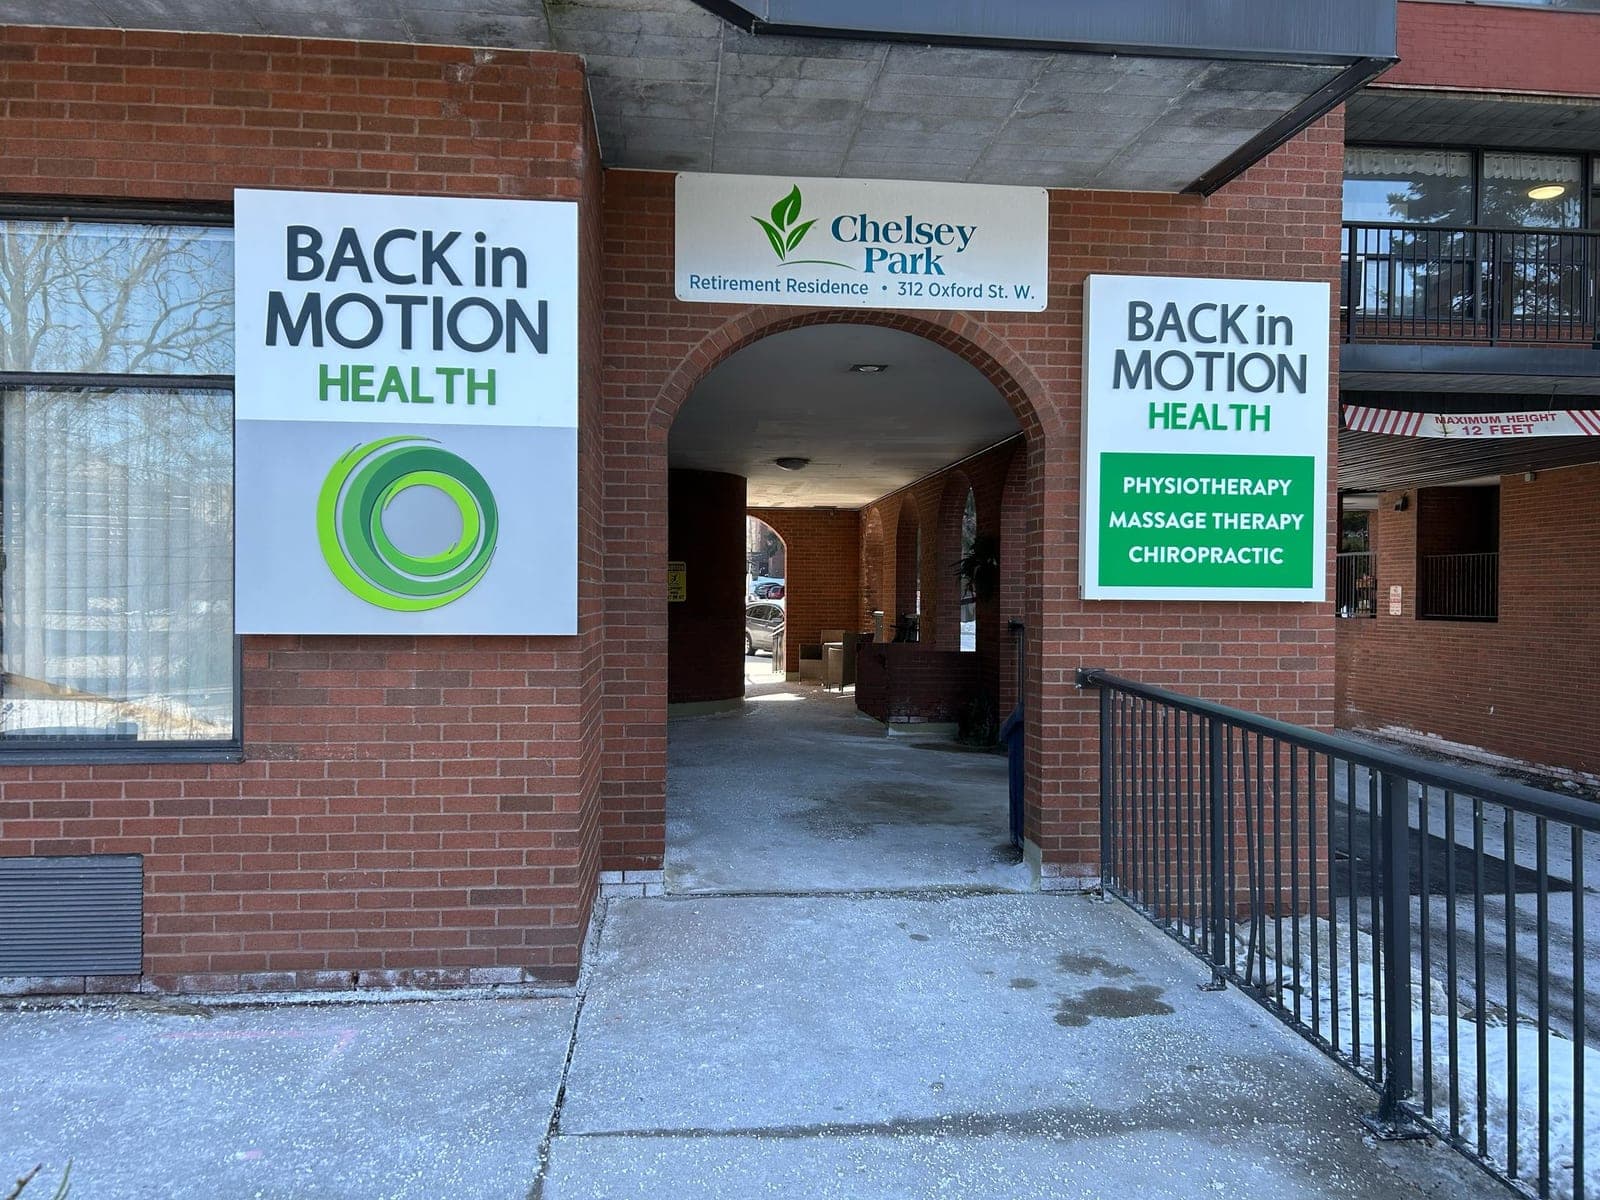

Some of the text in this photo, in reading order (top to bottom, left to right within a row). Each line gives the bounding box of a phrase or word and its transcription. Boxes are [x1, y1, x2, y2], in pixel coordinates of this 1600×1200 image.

[831, 213, 977, 253] Chelsey
[286, 225, 528, 289] BACK in
[864, 247, 946, 276] Park
[689, 274, 1035, 300] Retirement Residence 312 Oxford St. W.
[265, 290, 549, 355] MOTION
[1127, 300, 1294, 346] BACK in
[319, 363, 497, 406] HEALTH
[1112, 348, 1307, 394] MOTION
[1148, 401, 1271, 432] HEALTH
[1434, 413, 1557, 425] MAXIMUM HEIGHT
[1462, 423, 1535, 435] 12 FEET
[1123, 476, 1293, 496] PHYSIOTHERAPY
[1108, 511, 1305, 531] MASSAGE THERAPY
[1128, 545, 1284, 565] CHIROPRACTIC
